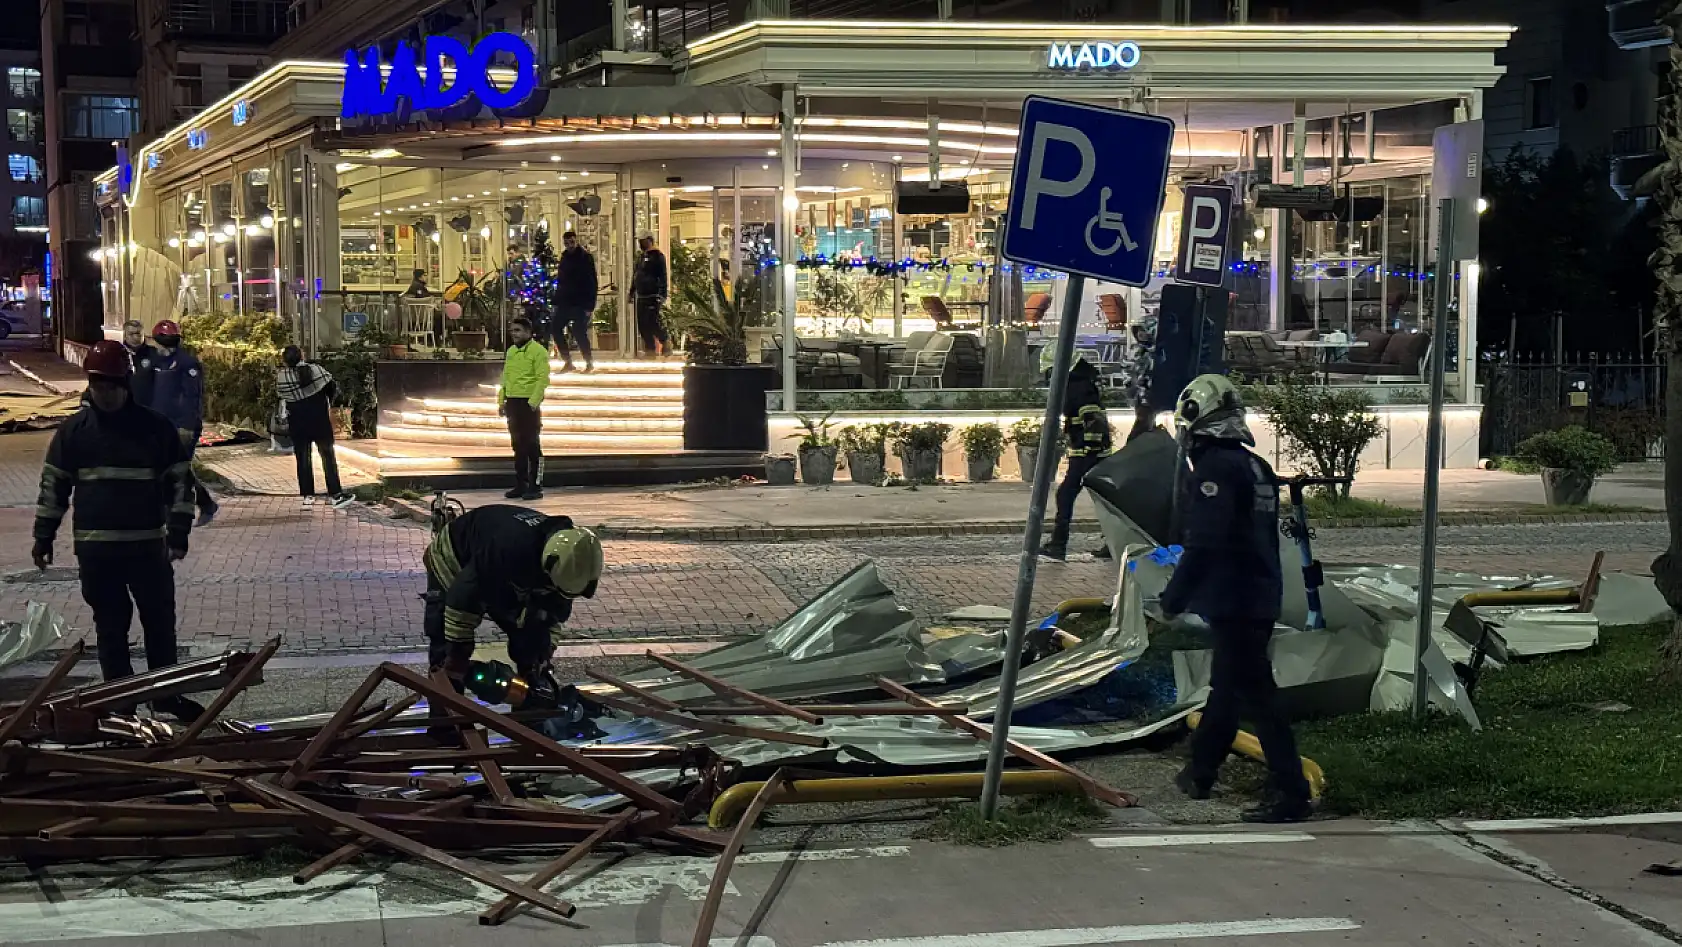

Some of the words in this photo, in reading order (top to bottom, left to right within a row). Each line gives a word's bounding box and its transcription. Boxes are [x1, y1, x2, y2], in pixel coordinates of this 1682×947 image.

[342, 32, 534, 118] MADO
[1048, 42, 1140, 67] MADO
[1020, 121, 1096, 230] P
[1185, 196, 1222, 273] P
